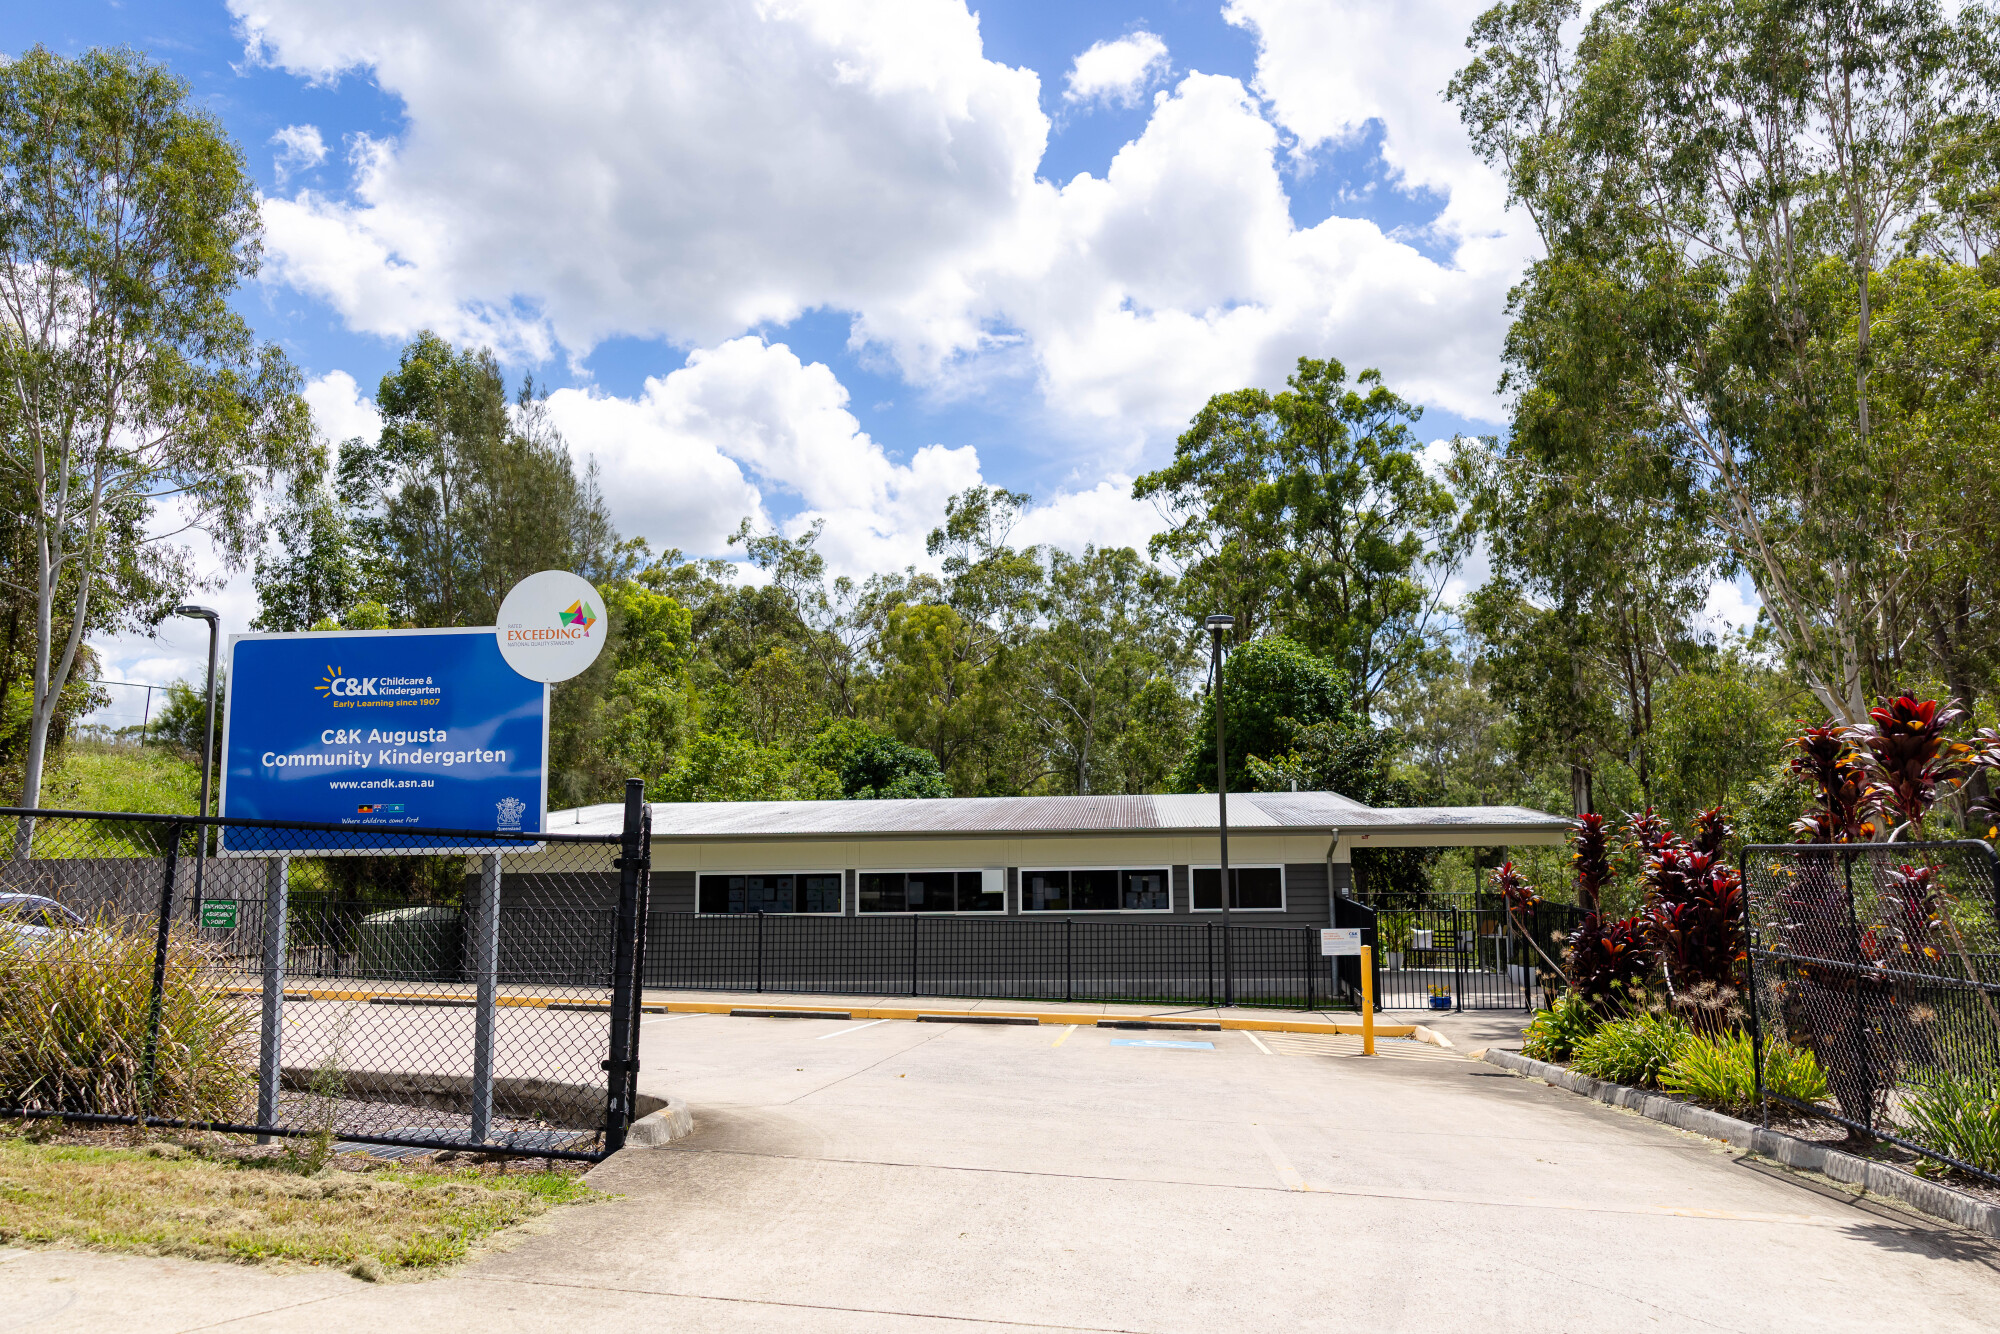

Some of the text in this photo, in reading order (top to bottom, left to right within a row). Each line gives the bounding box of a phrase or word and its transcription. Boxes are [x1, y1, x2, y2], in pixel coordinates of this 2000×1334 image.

[508, 628, 581, 640] EXCEEDING
[331, 677, 378, 696] C&K
[380, 676, 432, 686] Childcare &
[379, 686, 441, 696] Kindergarten
[333, 700, 355, 708] Early
[357, 699, 394, 708] Learning
[420, 698, 440, 706] 1907
[321, 728, 447, 746] C&K Augusta
[261, 748, 506, 769] Community Kindergarten
[329, 778, 435, 789] www.candk.asn.au
